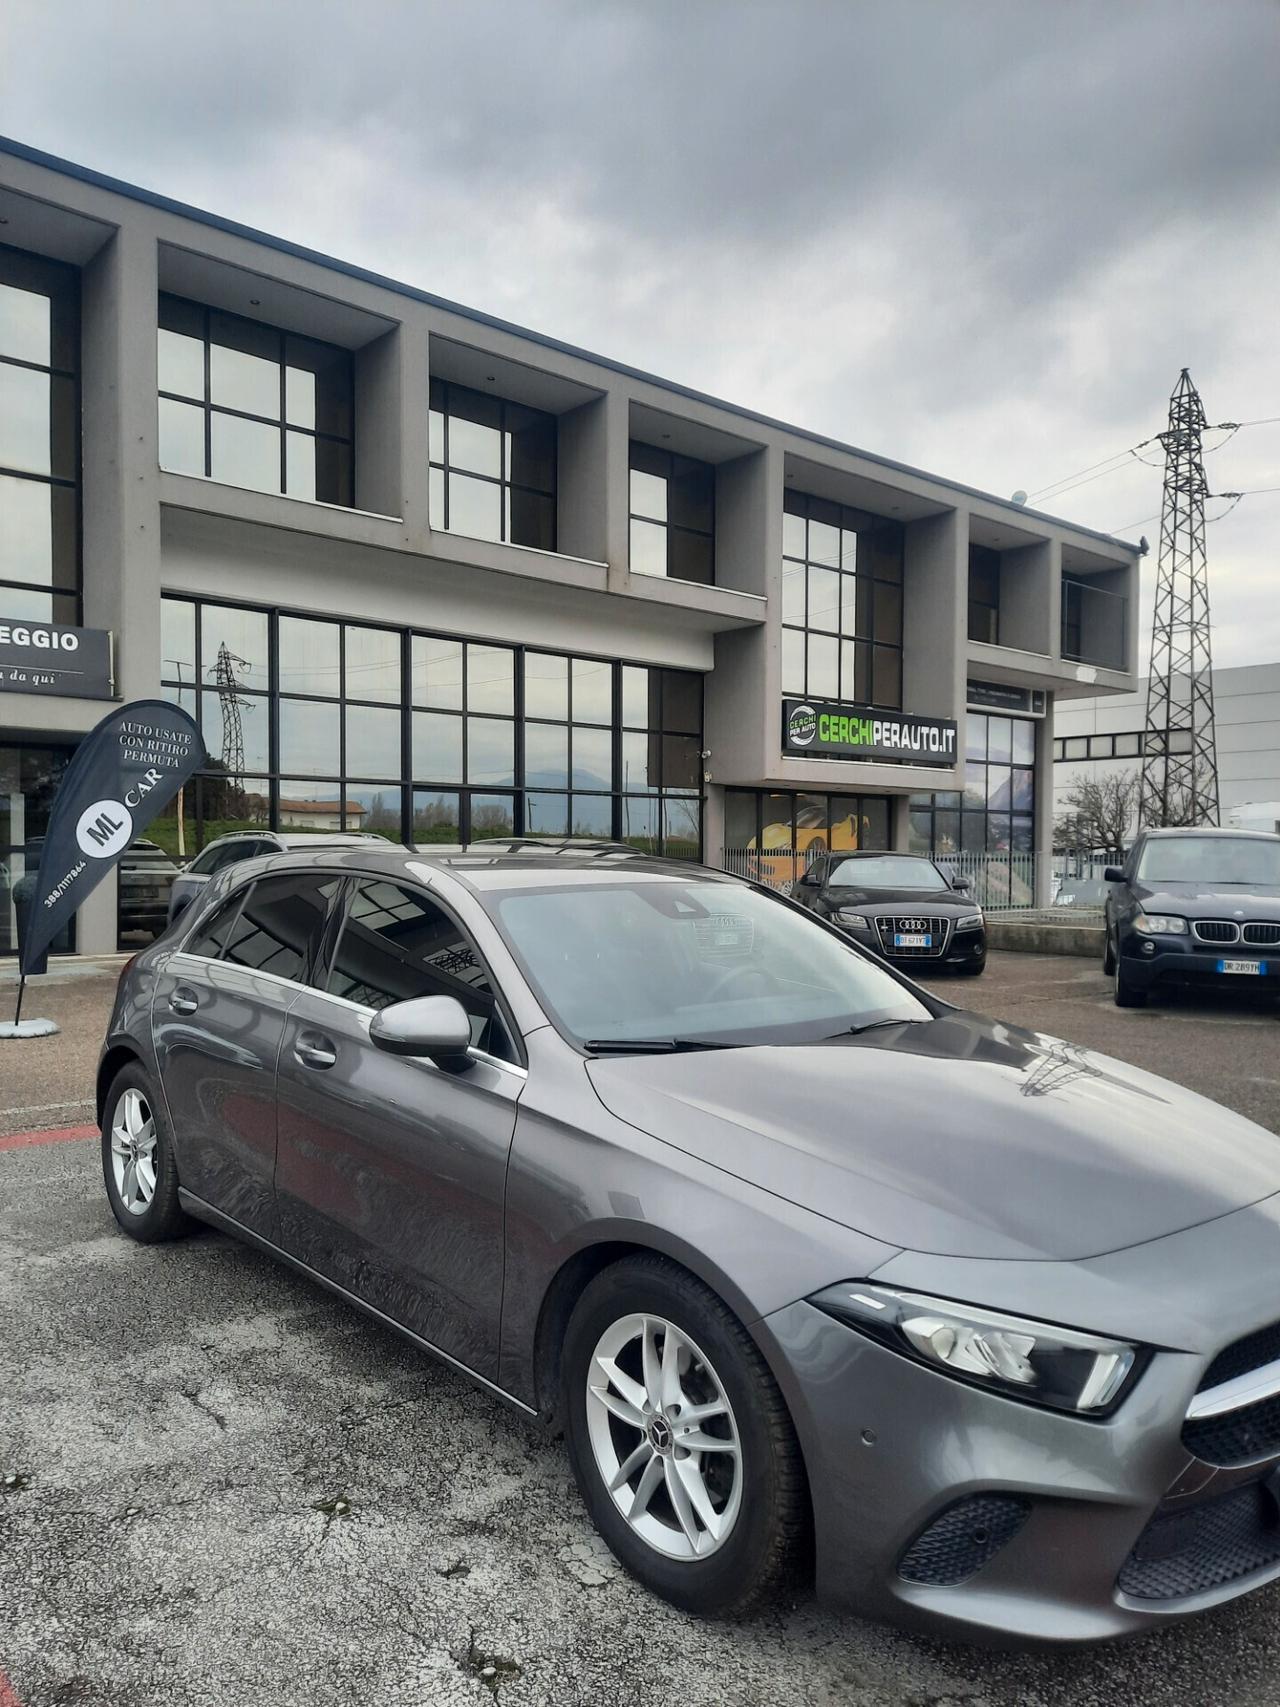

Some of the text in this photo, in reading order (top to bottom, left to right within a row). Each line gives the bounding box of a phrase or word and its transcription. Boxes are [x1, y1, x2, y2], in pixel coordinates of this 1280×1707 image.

[0, 626, 79, 651] EGGIO
[10, 669, 27, 681] da
[790, 714, 816, 729] CERCHI
[790, 723, 816, 737] PER AUTO
[119, 722, 192, 745] AUTO USATE
[818, 714, 955, 753] CERCHIPERAUTO.IT
[119, 735, 189, 757] CON RITIRO
[123, 750, 179, 768] PERMUTA
[125, 768, 164, 807] CAR
[86, 813, 123, 847] ML
[44, 860, 87, 908] 388/1117864
